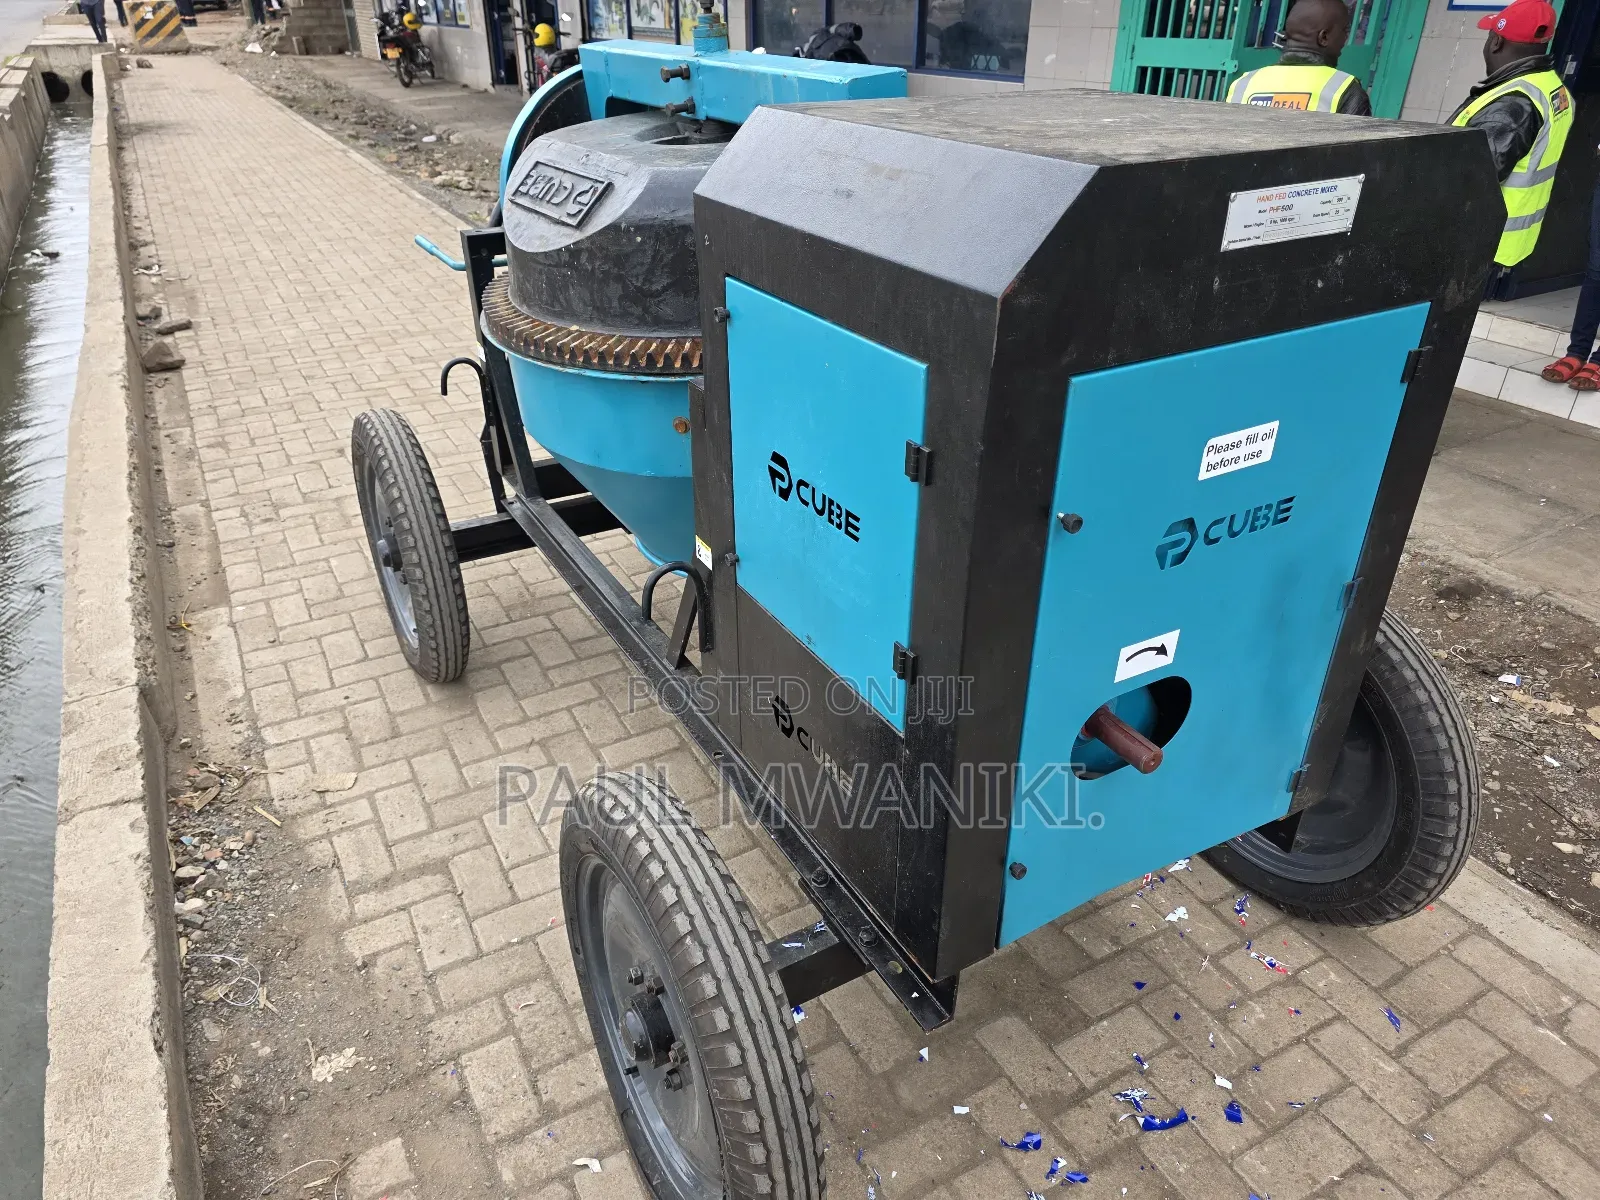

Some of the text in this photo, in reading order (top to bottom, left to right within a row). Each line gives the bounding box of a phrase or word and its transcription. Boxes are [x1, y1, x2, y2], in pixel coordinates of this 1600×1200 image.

[1257, 185, 1338, 203] HAND FED CONCRETE MIXER
[1205, 428, 1275, 457] Please fill oil
[1205, 449, 1263, 473] before use
[796, 478, 861, 543] CUBE
[1203, 495, 1298, 546] CUBE
